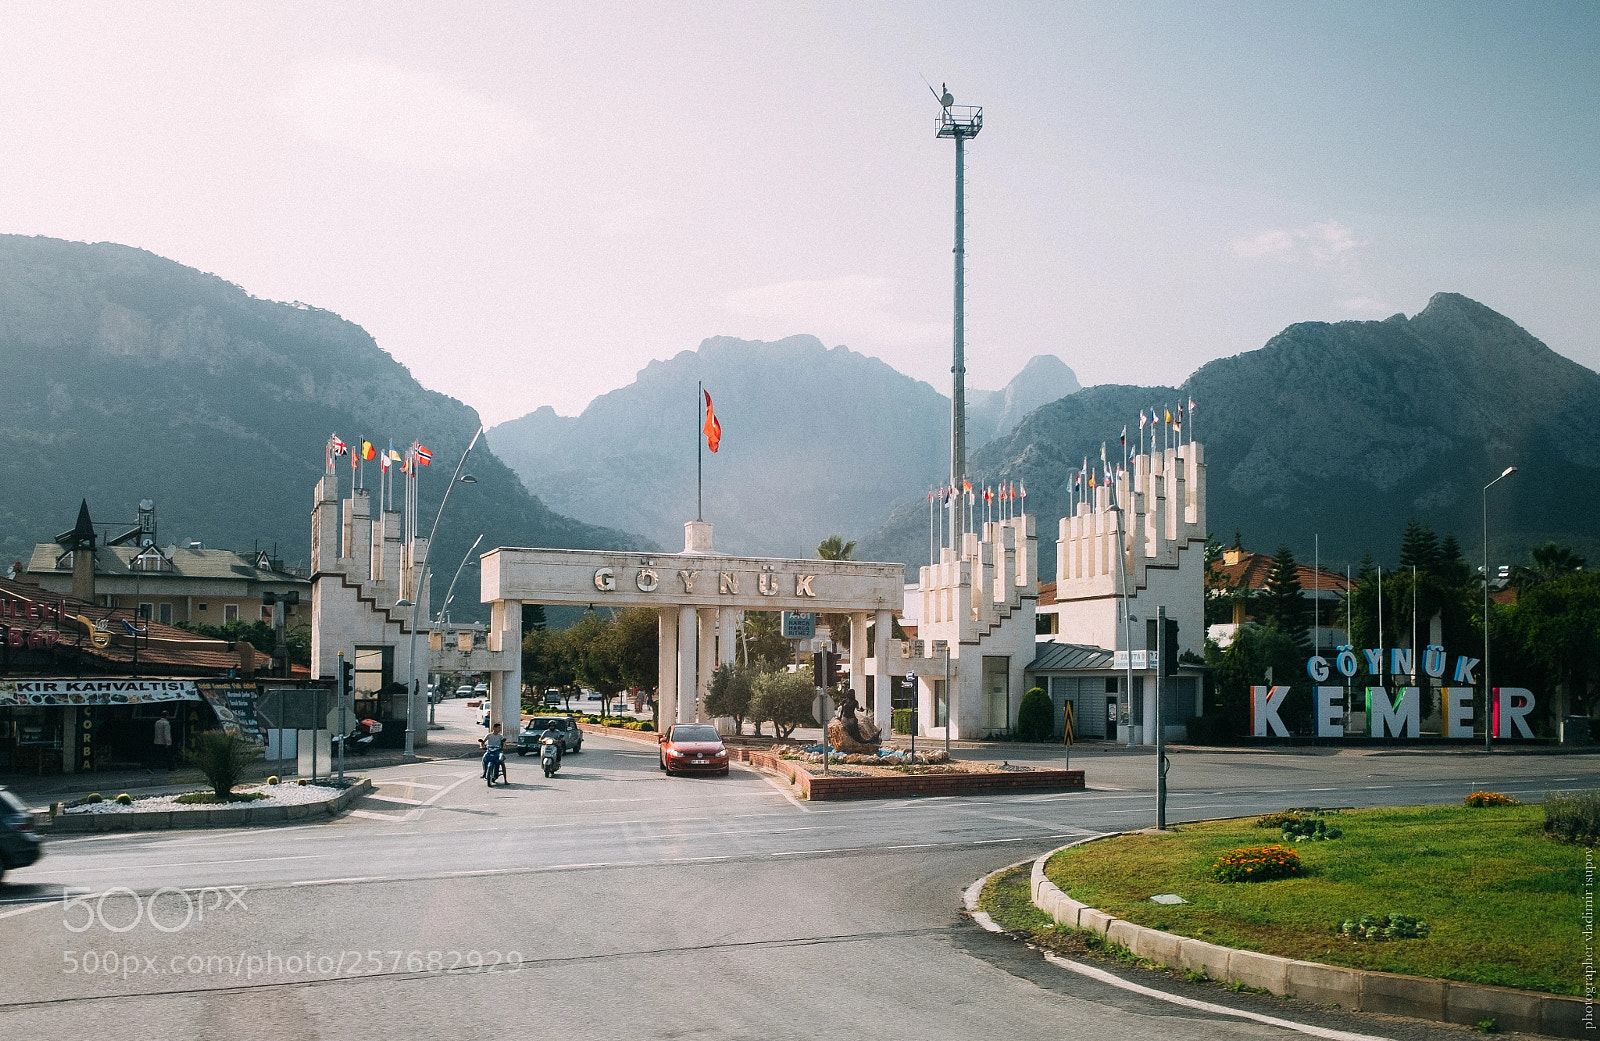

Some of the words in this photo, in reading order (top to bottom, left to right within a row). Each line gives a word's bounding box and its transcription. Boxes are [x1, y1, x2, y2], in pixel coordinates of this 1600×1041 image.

[593, 558, 817, 598] GÖYNÜK
[1307, 644, 1480, 684] GÖYNÜK
[17, 682, 58, 692] KIR
[66, 682, 186, 692] KAHVALTISI
[1250, 685, 1536, 738] KEMER
